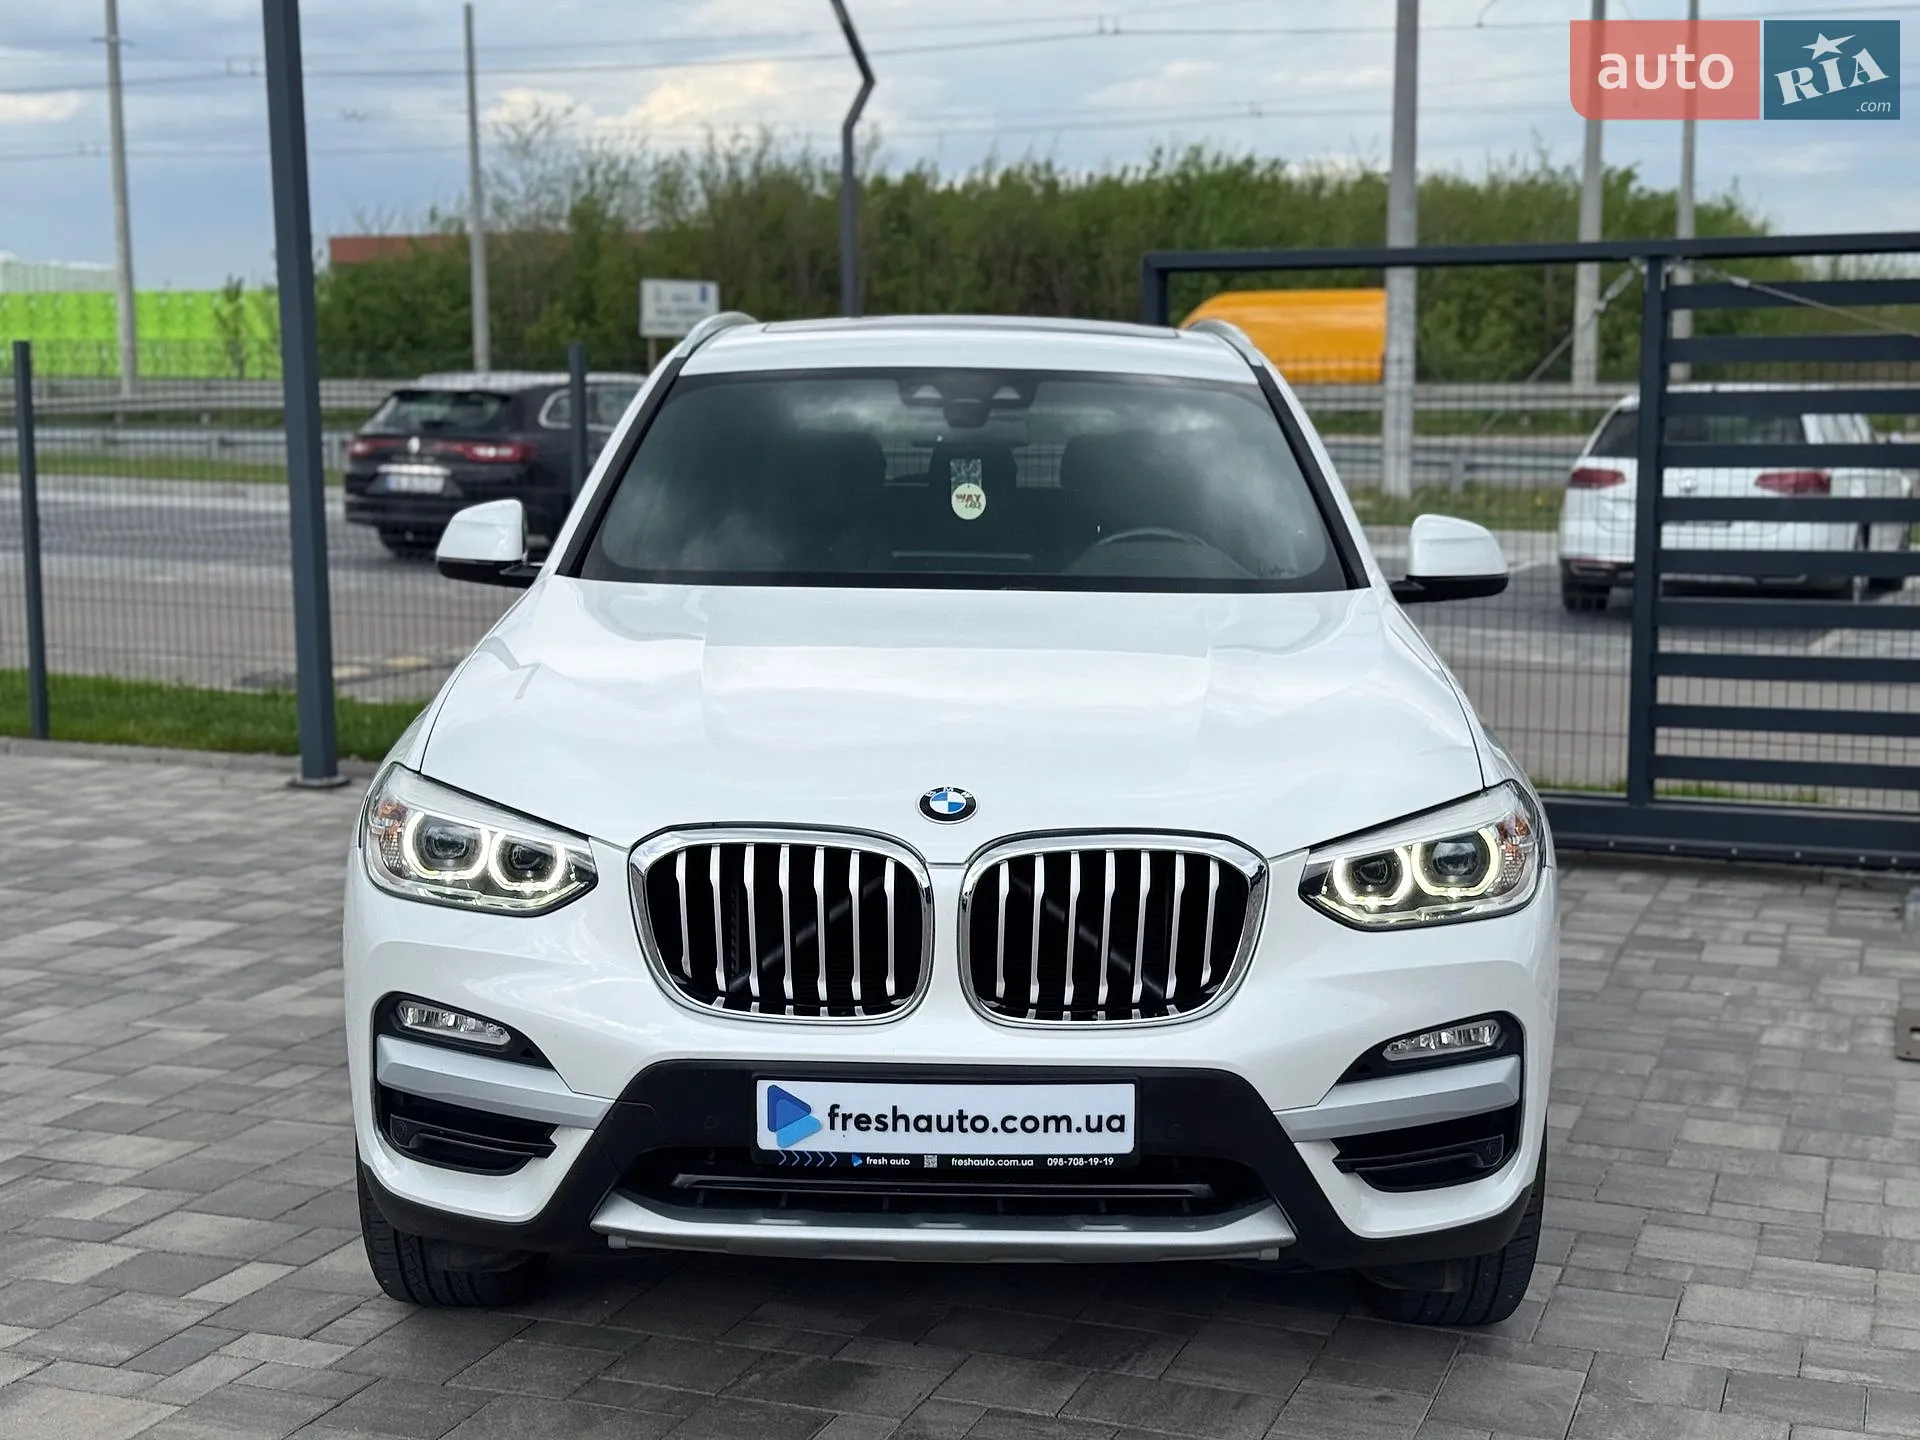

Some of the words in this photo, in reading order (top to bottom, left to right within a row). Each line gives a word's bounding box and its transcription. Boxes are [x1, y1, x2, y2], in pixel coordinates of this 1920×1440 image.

[828, 1104, 1126, 1133] freshauto.com.ua
[866, 1156, 888, 1166] fresh
[890, 1157, 911, 1166] auto
[951, 1157, 1034, 1167] freshauto.com.ua
[1047, 1157, 1114, 1167] 098-708-19-19
